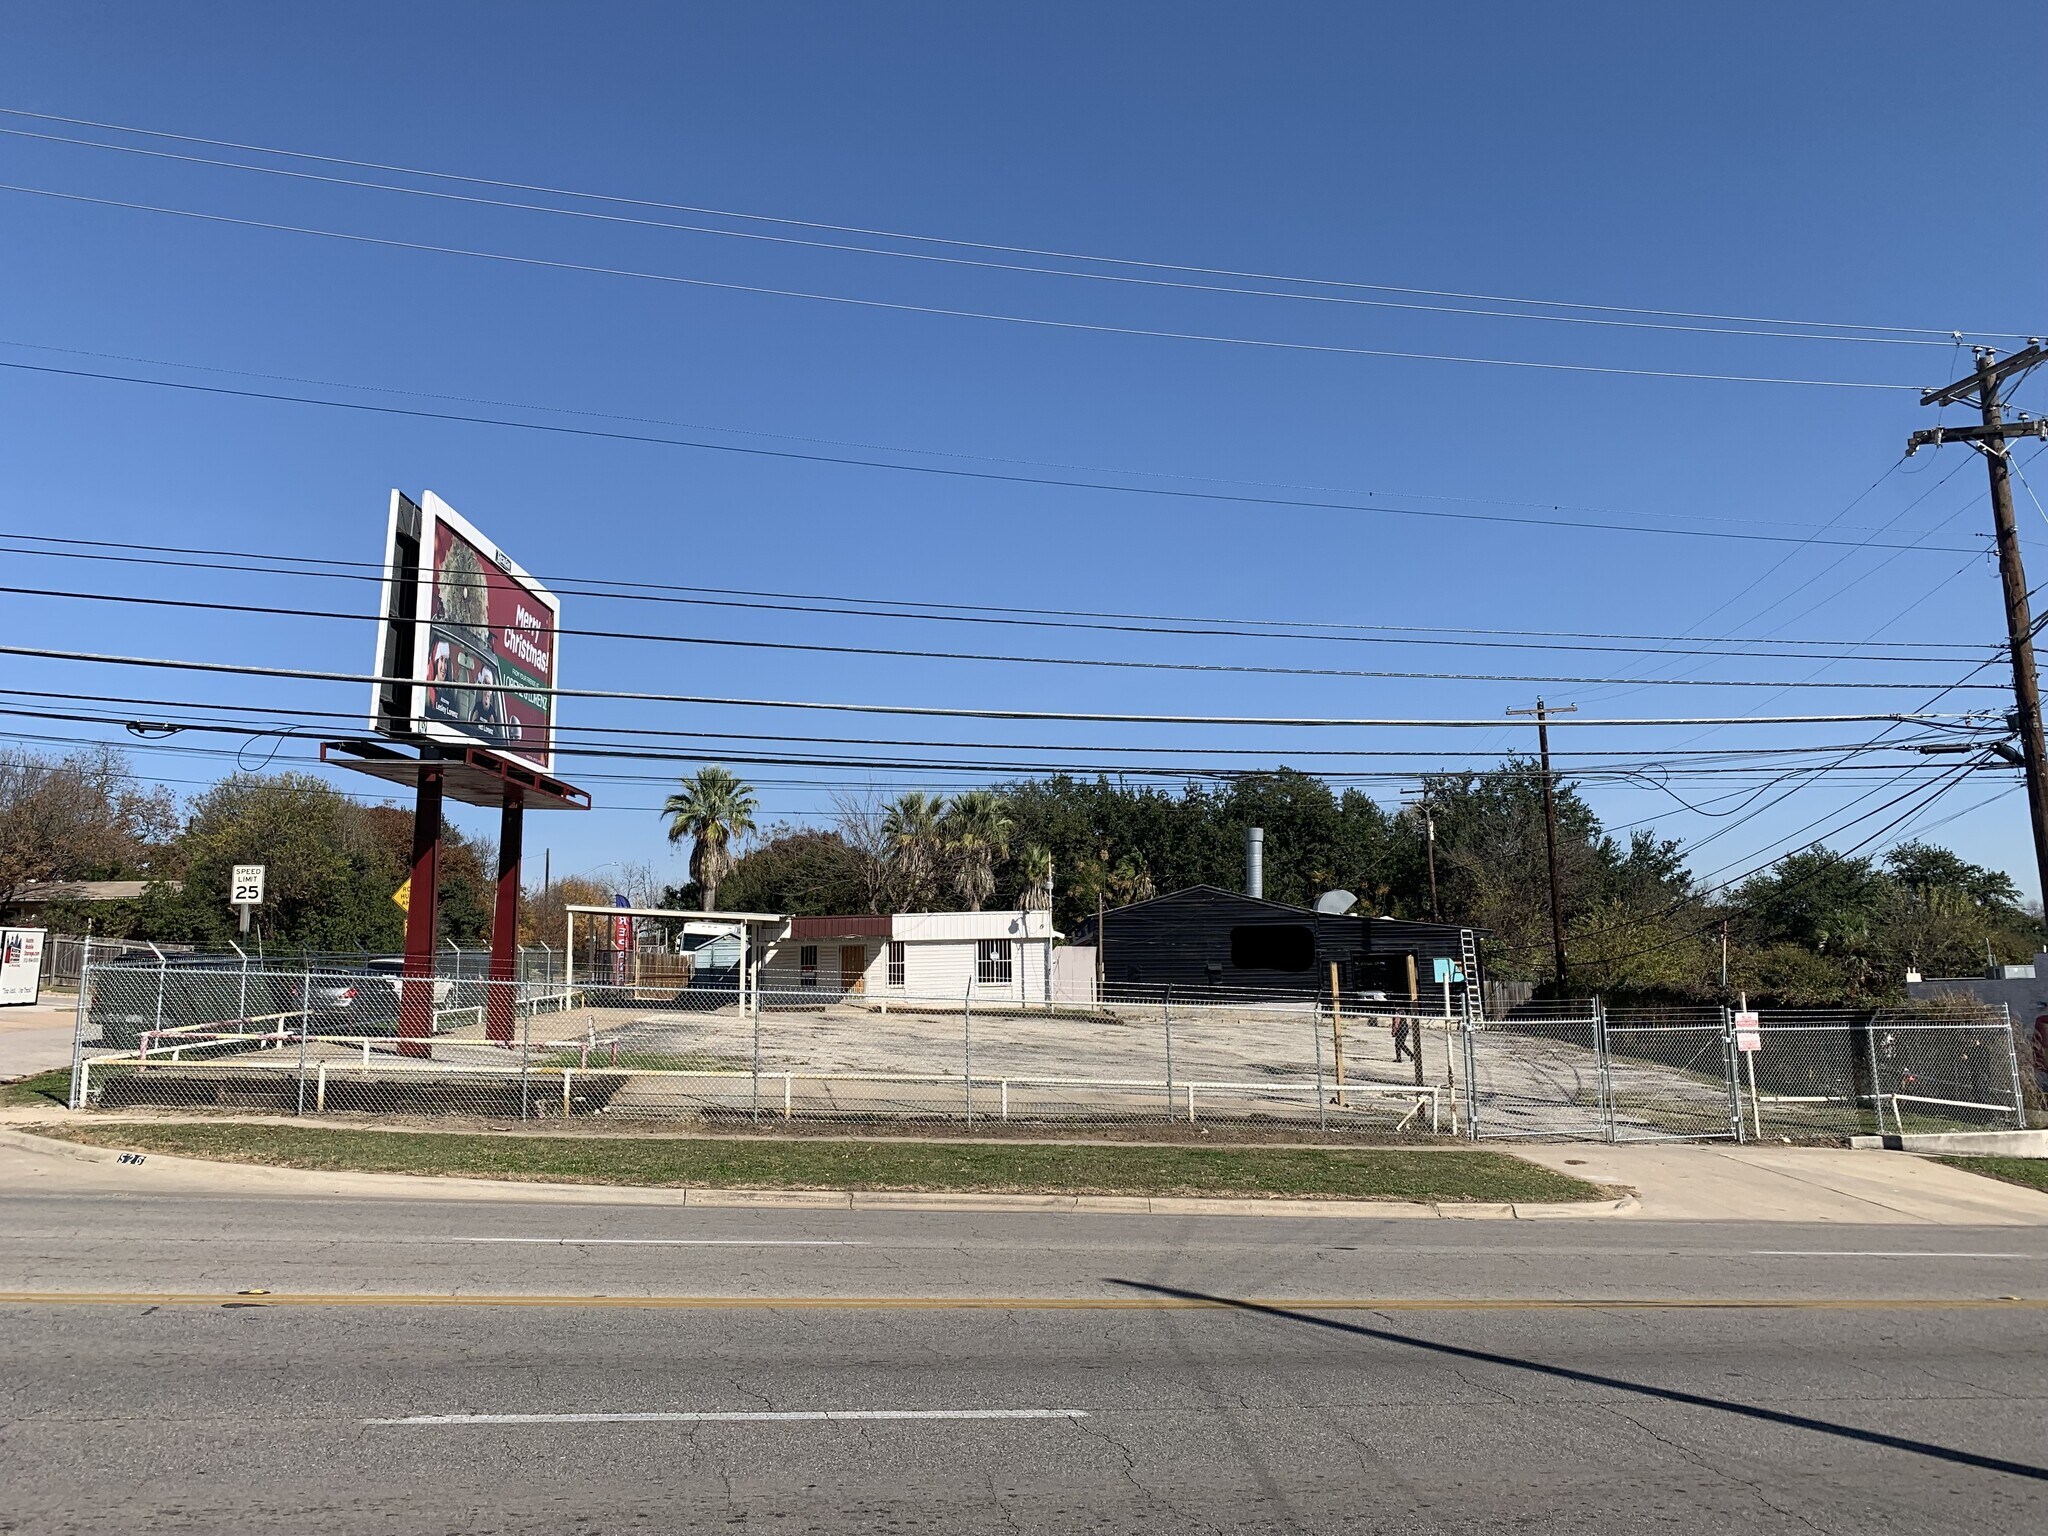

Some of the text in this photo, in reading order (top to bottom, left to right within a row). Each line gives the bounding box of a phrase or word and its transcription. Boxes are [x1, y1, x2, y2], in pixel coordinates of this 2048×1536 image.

[515, 604, 541, 643] Merry
[503, 625, 549, 673] Christmas!
[235, 885, 259, 899] 25
[119, 1153, 144, 1165] 526
